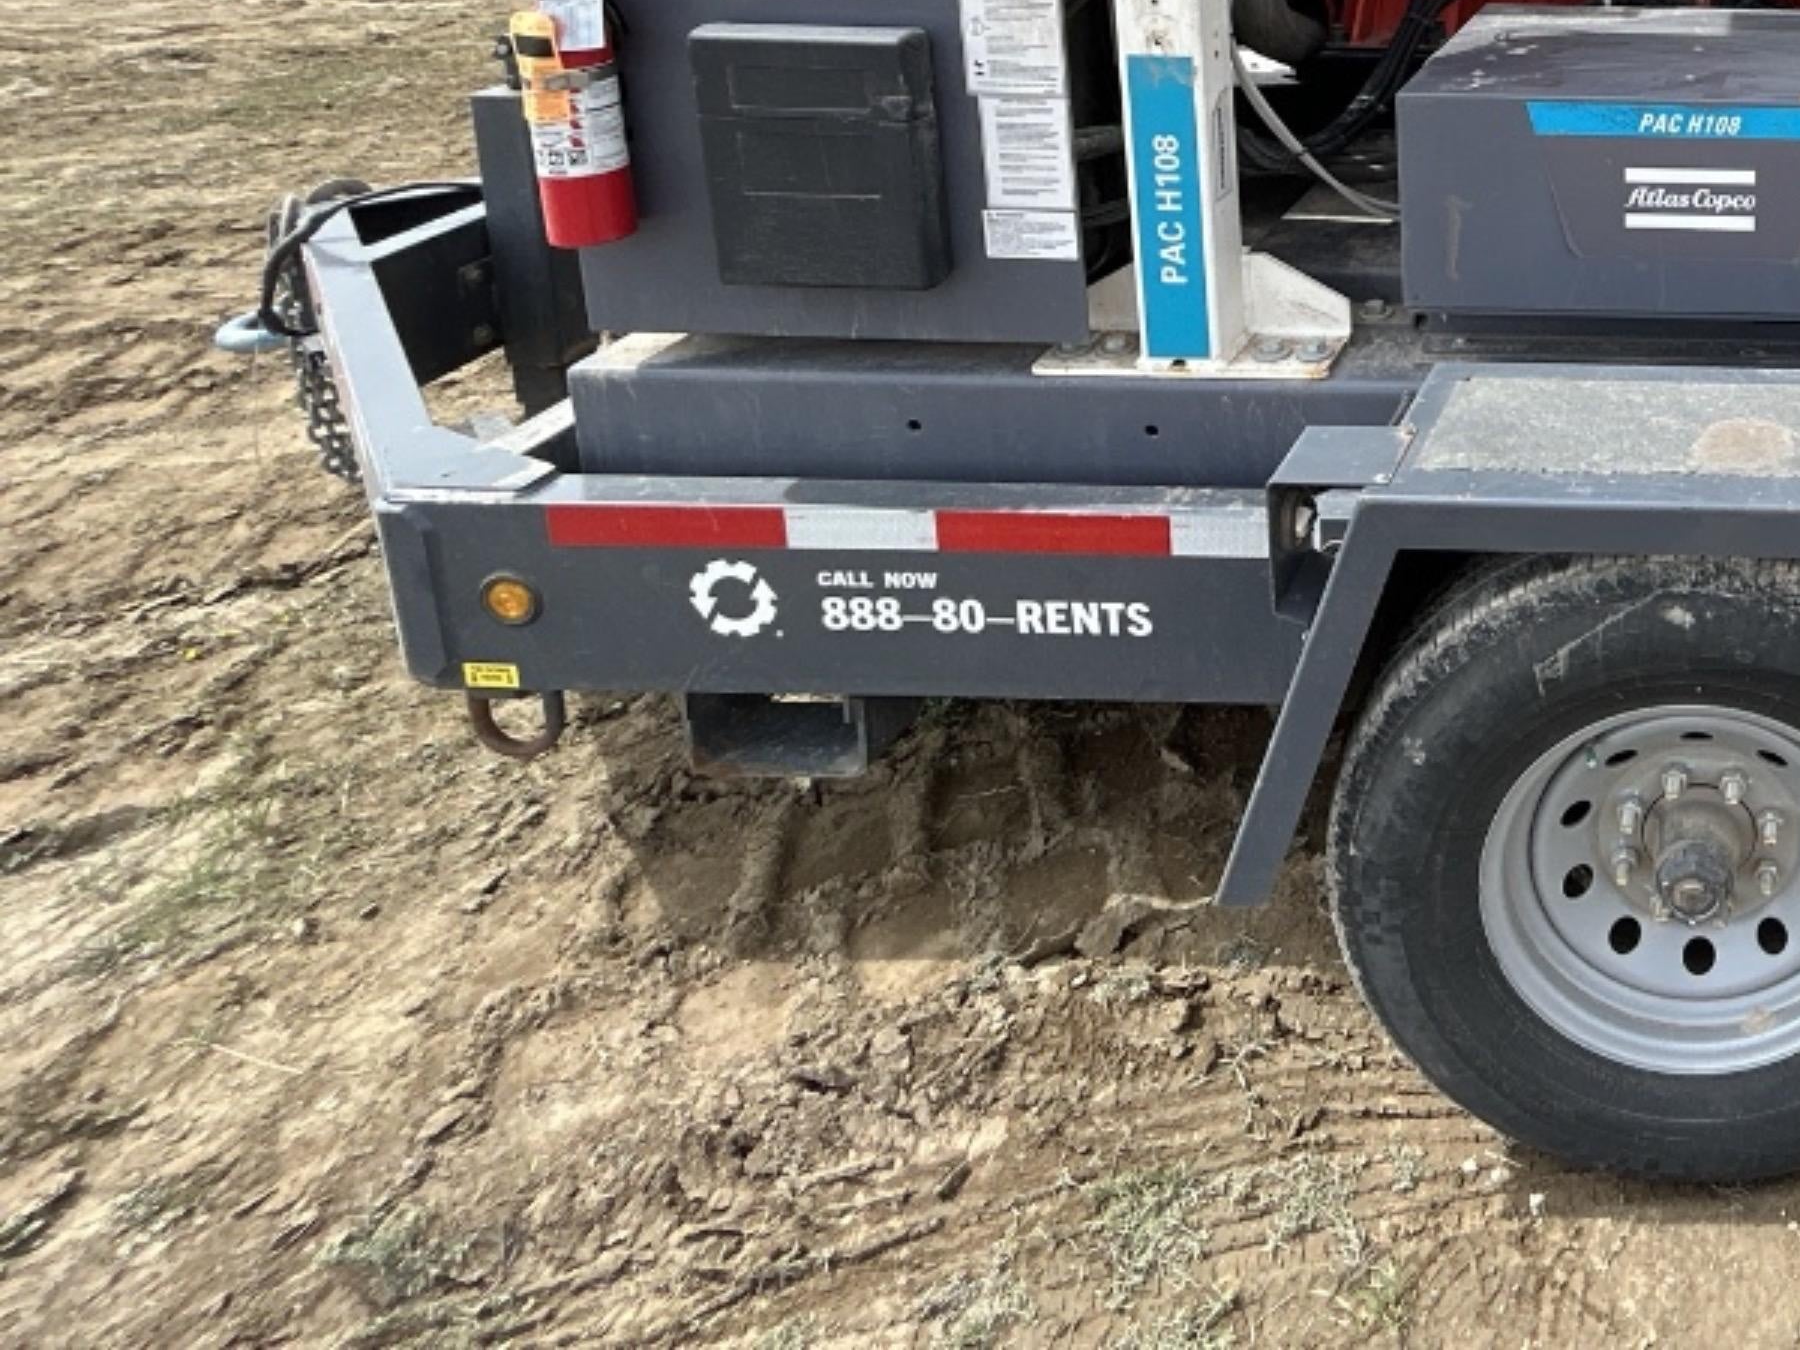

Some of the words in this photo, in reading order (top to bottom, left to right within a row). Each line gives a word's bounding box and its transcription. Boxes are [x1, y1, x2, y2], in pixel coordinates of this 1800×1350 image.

[1638, 112, 1684, 133] PAC
[1685, 113, 1743, 137] H108
[1152, 133, 1184, 212] H108
[1624, 185, 1691, 209] Atlas
[1691, 188, 1757, 215] Copco
[1157, 221, 1189, 284] PAC
[816, 571, 875, 589] CALL
[883, 572, 939, 590] NOW
